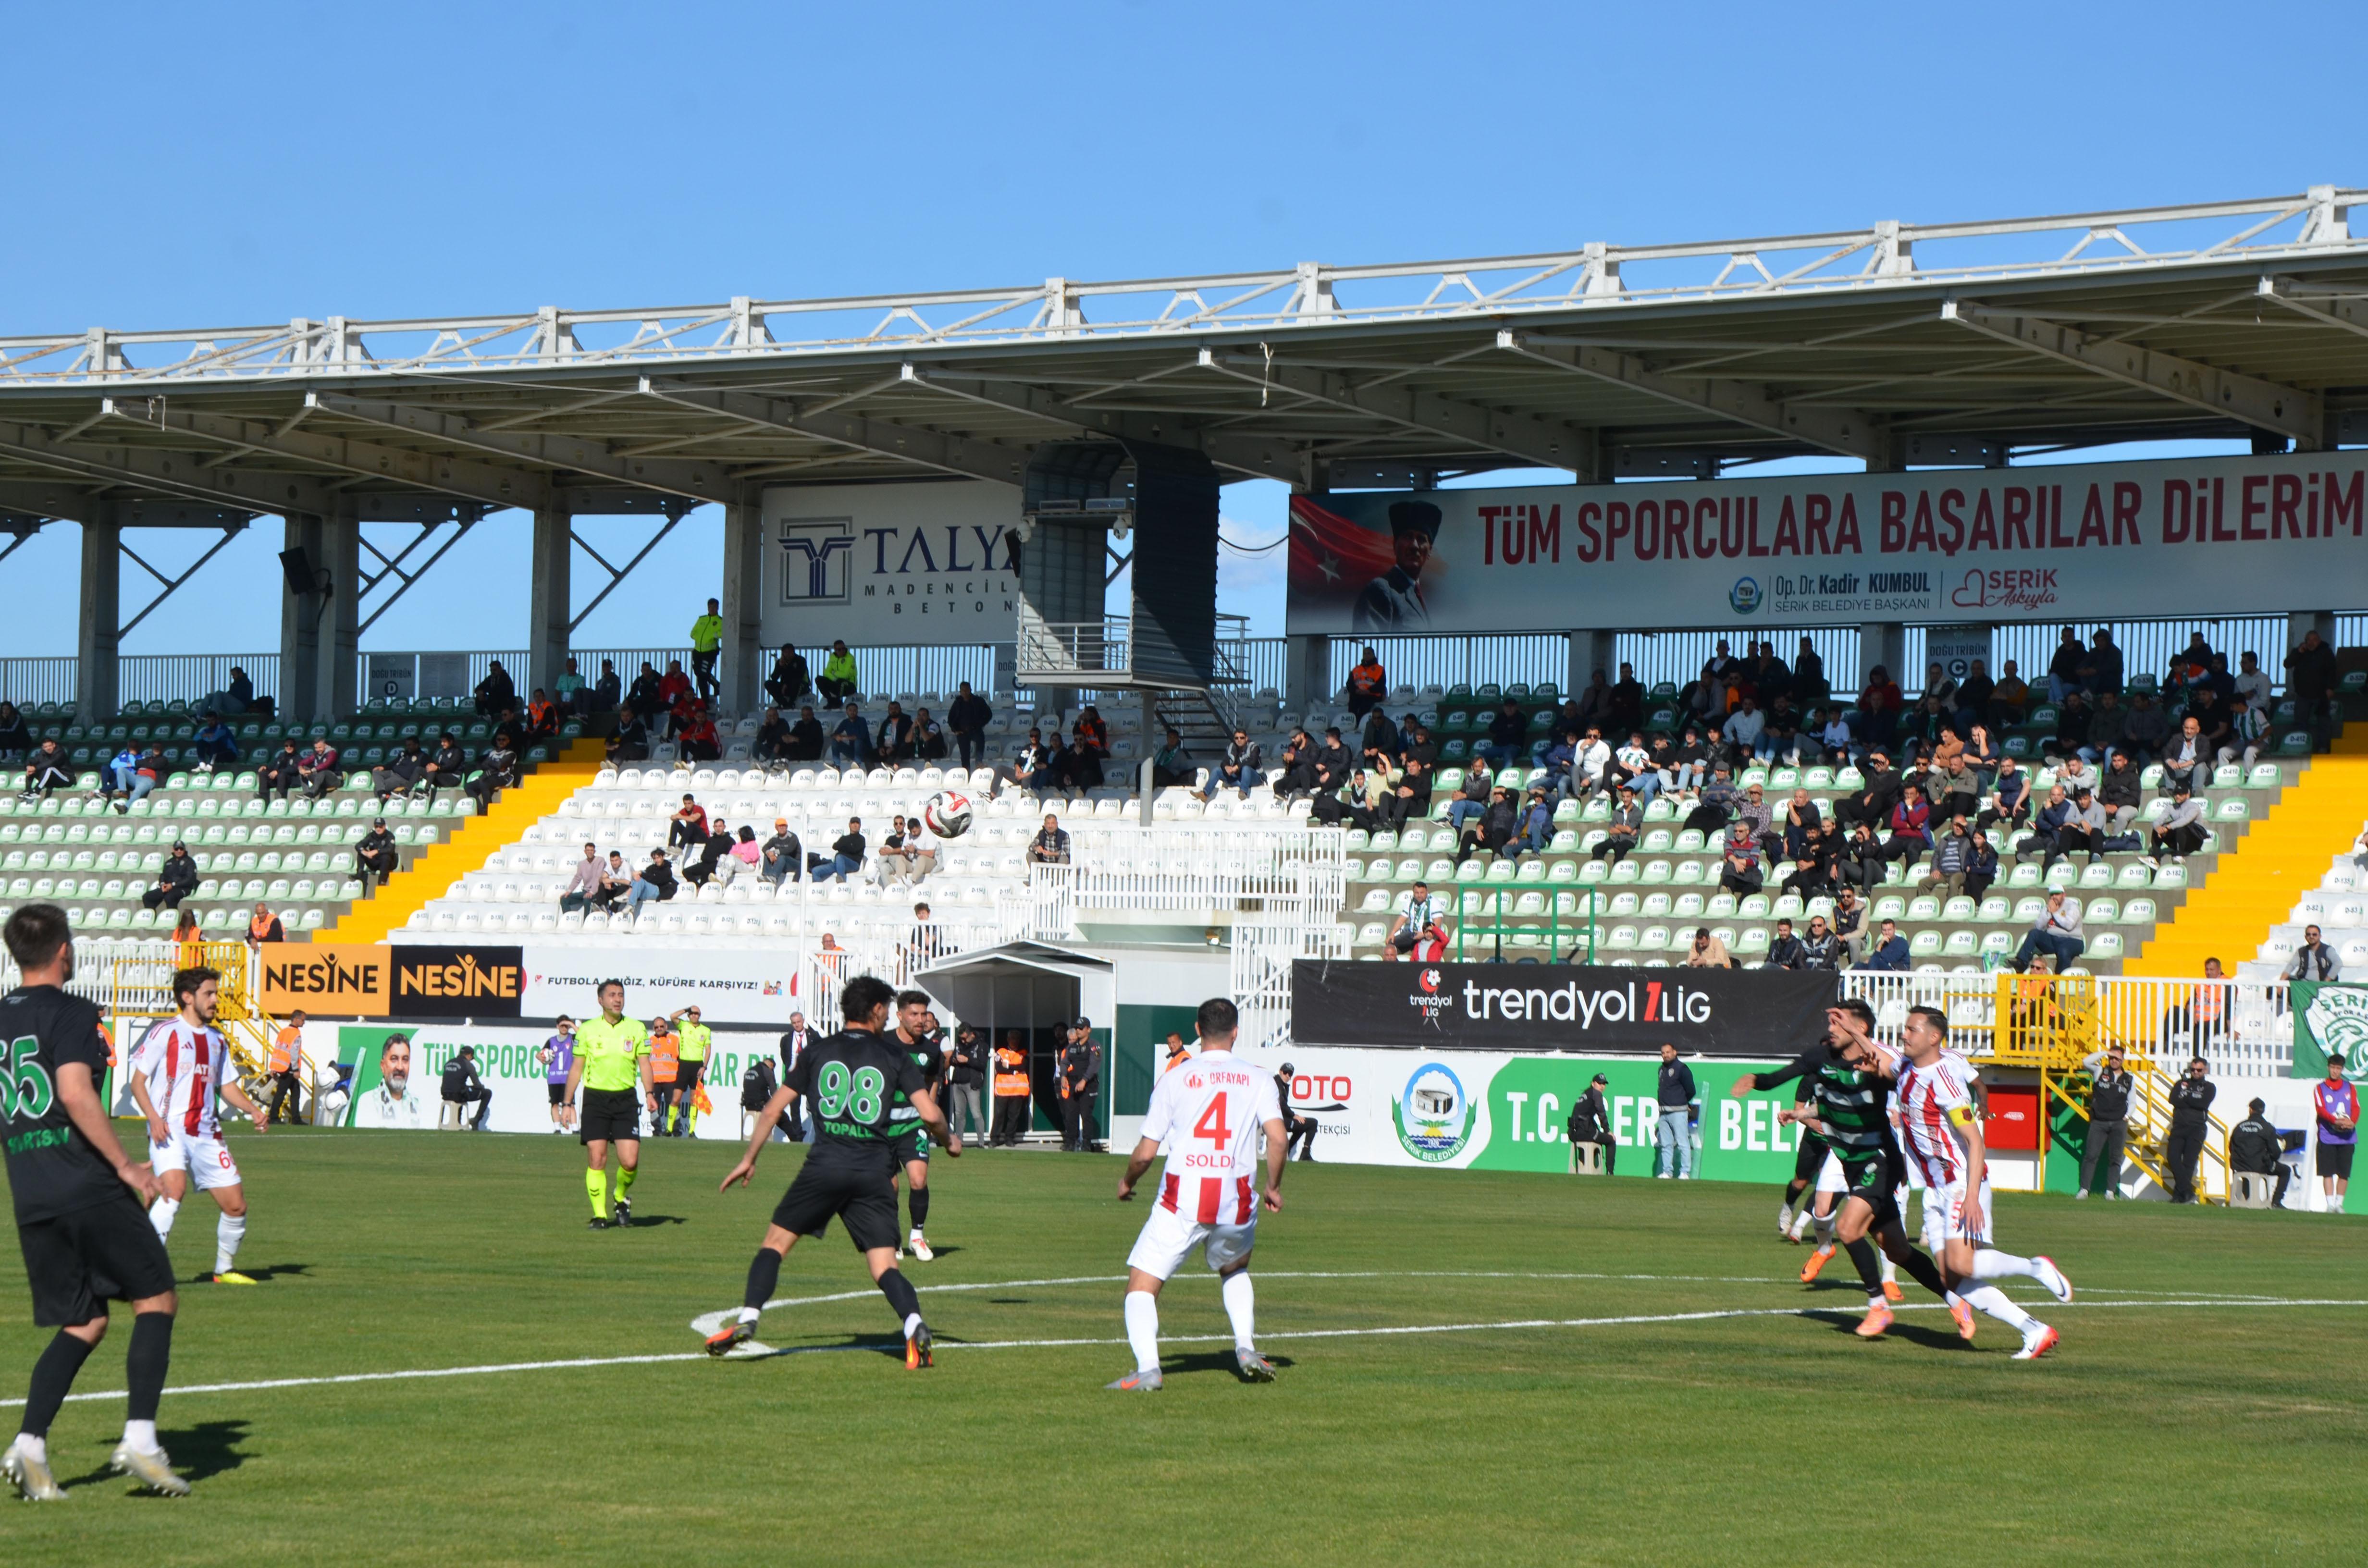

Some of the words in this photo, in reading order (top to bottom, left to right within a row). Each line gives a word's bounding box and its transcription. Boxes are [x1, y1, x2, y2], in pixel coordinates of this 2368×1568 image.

[1479, 504, 1561, 566] TÜM
[1578, 491, 1862, 564] SPORCULARA
[1880, 481, 2142, 558] BAŞARILAR
[2163, 470, 2365, 544] DİLERİM
[1776, 576, 1795, 599] Op.
[1799, 576, 1815, 595] Dr.
[1819, 574, 1860, 594] Kadir
[1869, 572, 1930, 593] KUMBUL
[1988, 568, 2058, 590] SERİK
[894, 600, 1013, 614] BETON
[1775, 600, 1809, 612] SERİK
[1813, 599, 1871, 612] BELEDİYE
[1875, 598, 1930, 612] BAŞKANI
[1930, 644, 1953, 656] DOĞU
[1956, 643, 1987, 655] TRİBÜN
[1951, 662, 1964, 674] C
[387, 684, 396, 694] D
[548, 977, 600, 985] FUTBOLA
[649, 978, 695, 988] KÜFÜRE
[699, 980, 758, 990] KARŞIYIZ!
[1409, 994, 1452, 1008] trendyol
[1462, 980, 1635, 1029] trendyol
[558, 1051, 564, 1070] 1
[818, 1060, 885, 1125] 98
[1194, 1091, 1232, 1150] 4
